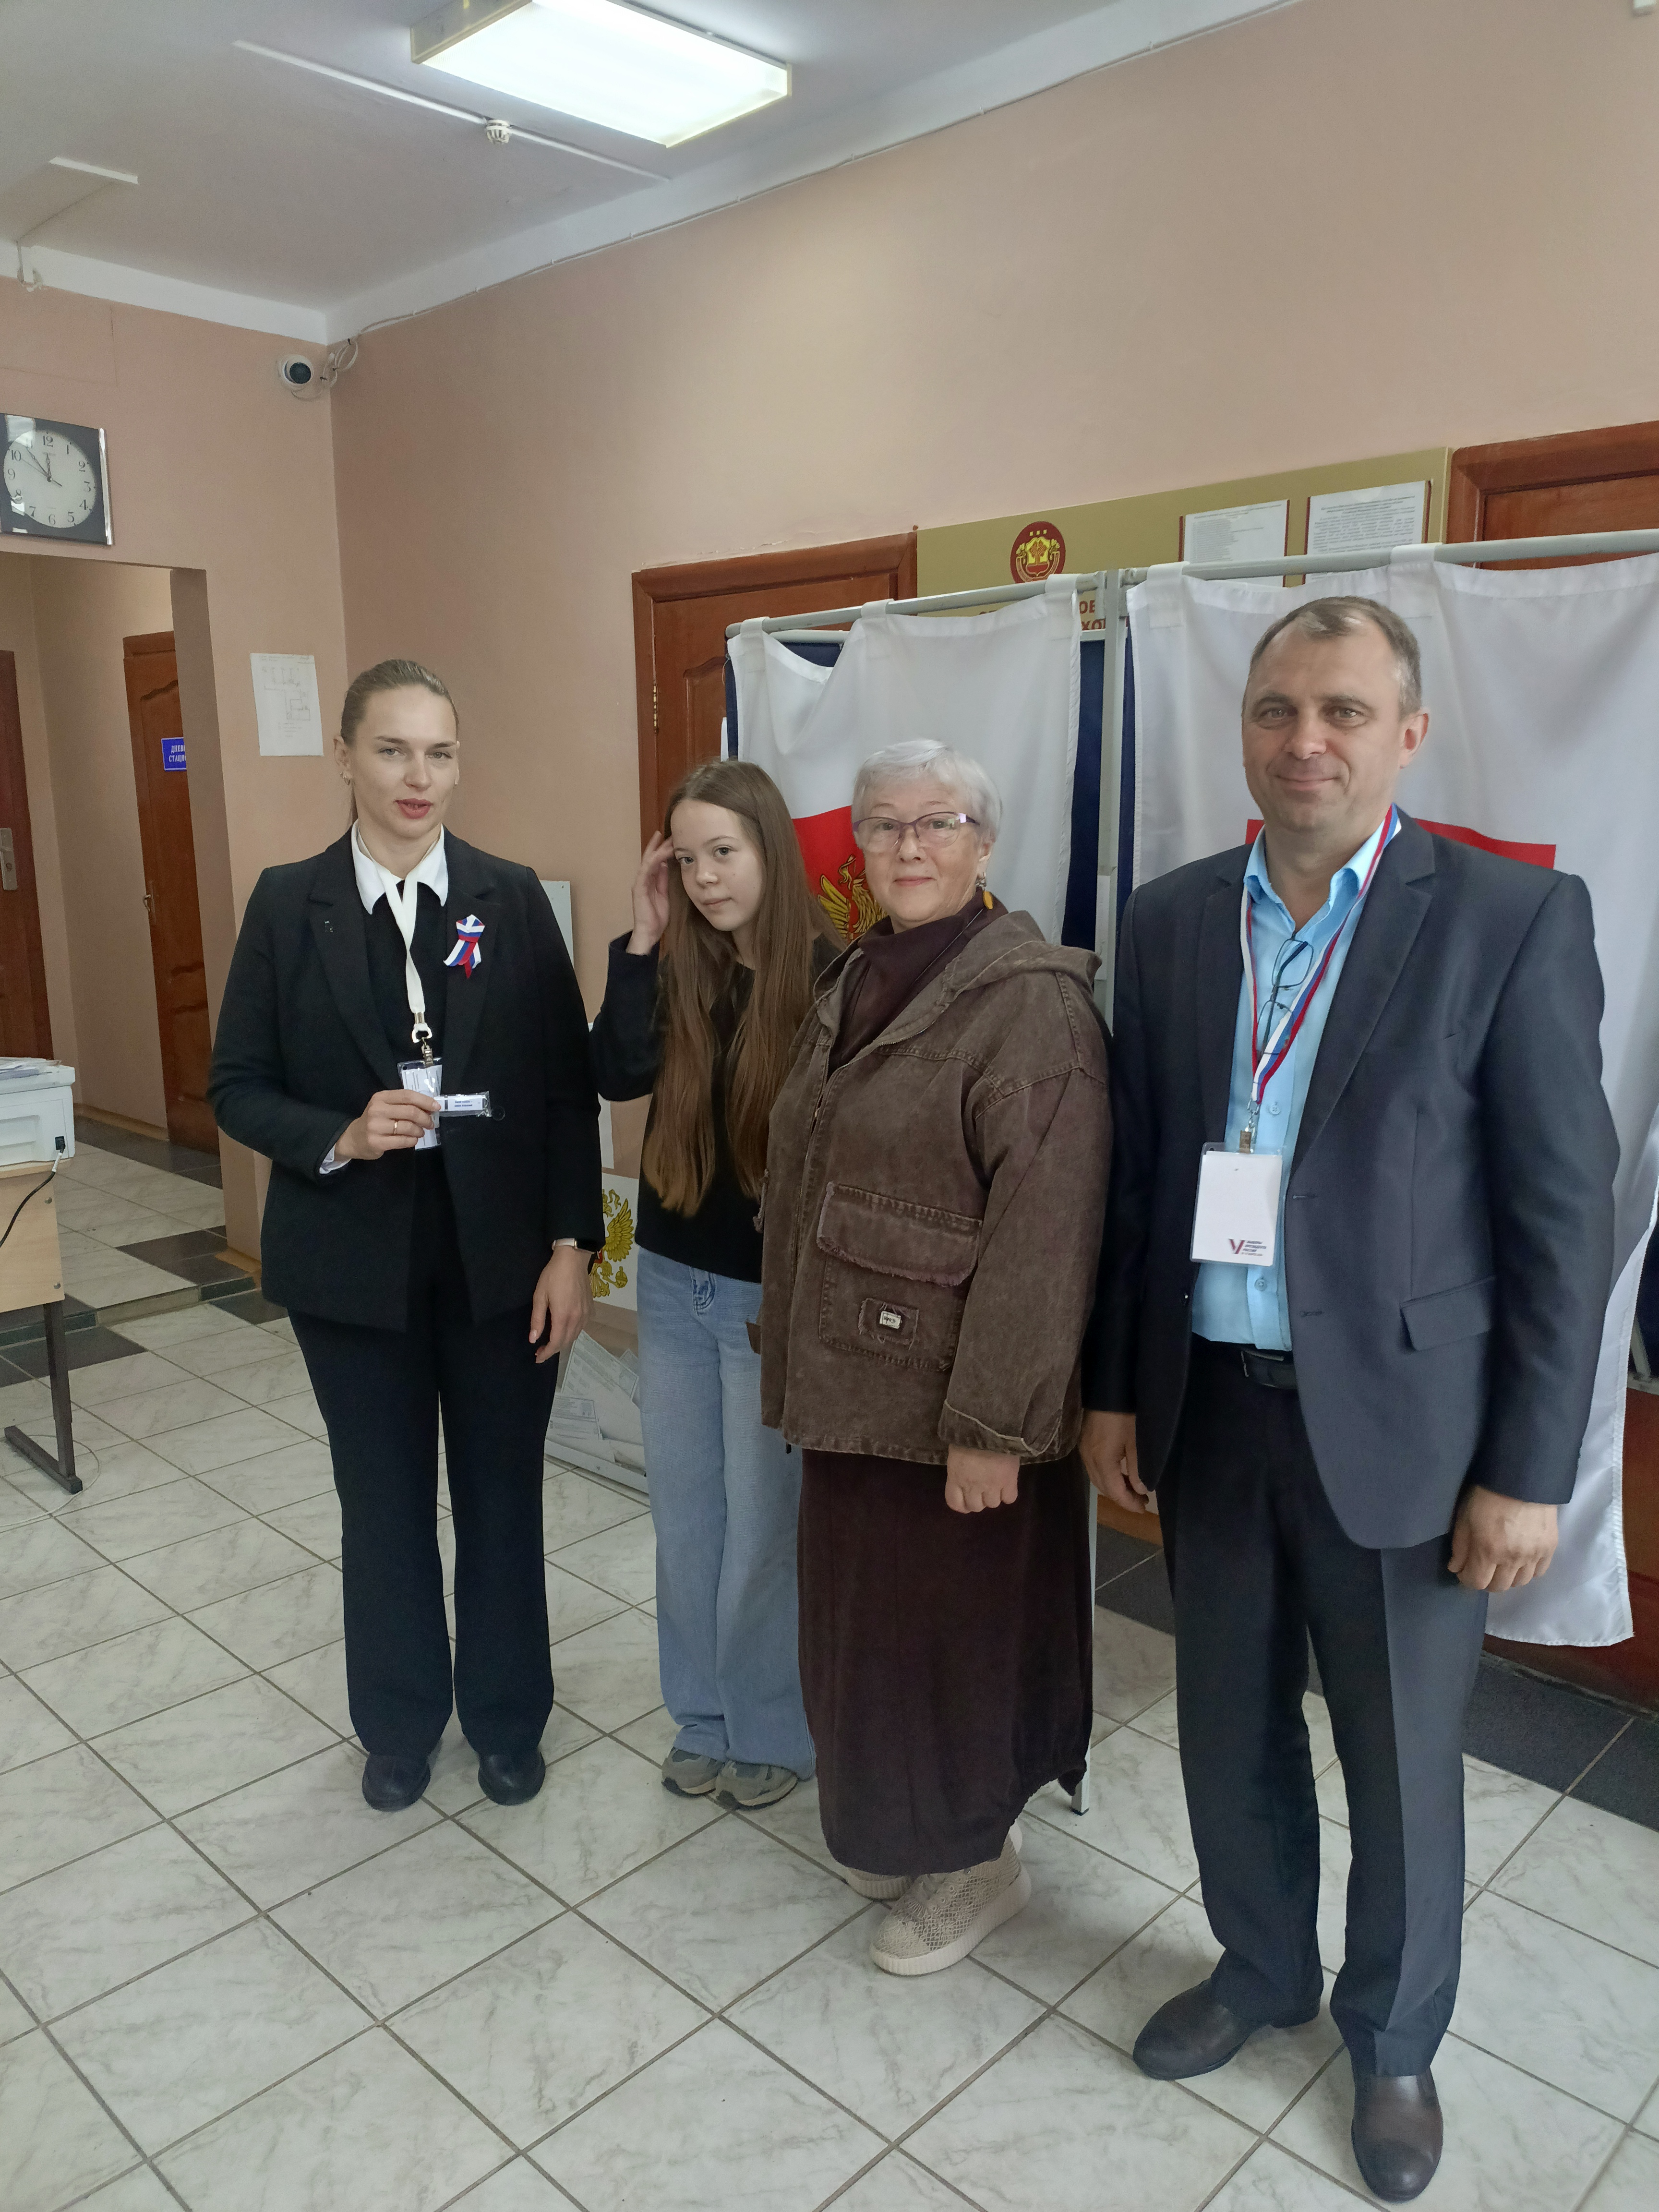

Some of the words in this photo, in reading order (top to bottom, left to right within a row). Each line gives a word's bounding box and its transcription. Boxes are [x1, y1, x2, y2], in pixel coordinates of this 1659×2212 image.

[43, 435, 53, 447] 12
[11, 450, 22, 461] 10
[66, 445, 69, 455] 1
[79, 461, 85, 472] 2
[8, 469, 15, 480] 9
[84, 481, 91, 492] 3
[79, 499, 87, 510] 4
[29, 505, 36, 517] 7
[67, 511, 74, 522] 5
[48, 514, 56, 525] 6
